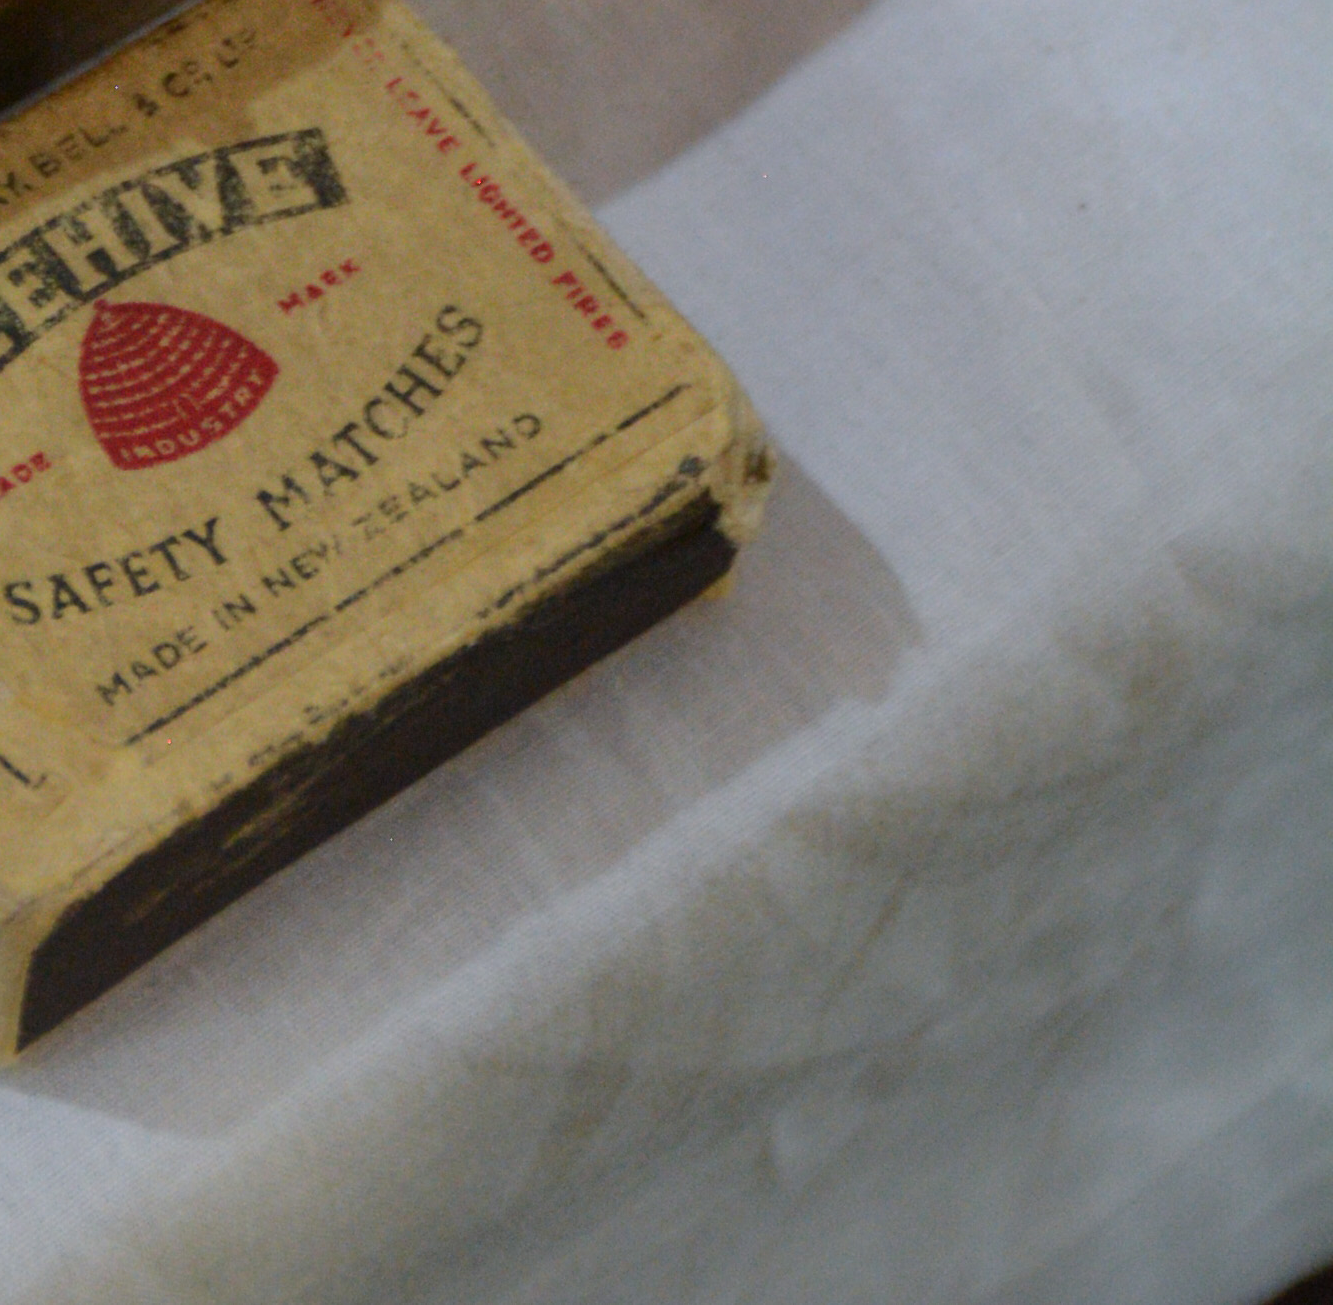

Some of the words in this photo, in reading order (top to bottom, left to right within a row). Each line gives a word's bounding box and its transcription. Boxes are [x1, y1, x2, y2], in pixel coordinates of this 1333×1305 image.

[275, 257, 362, 315] MARK
[458, 161, 555, 267] LIGHTED
[2, 516, 231, 628] SAFETY
[254, 302, 485, 533] MATCHES
[93, 624, 210, 708] MADE
[211, 591, 257, 633] IN
[350, 411, 544, 543] ZEALAND
